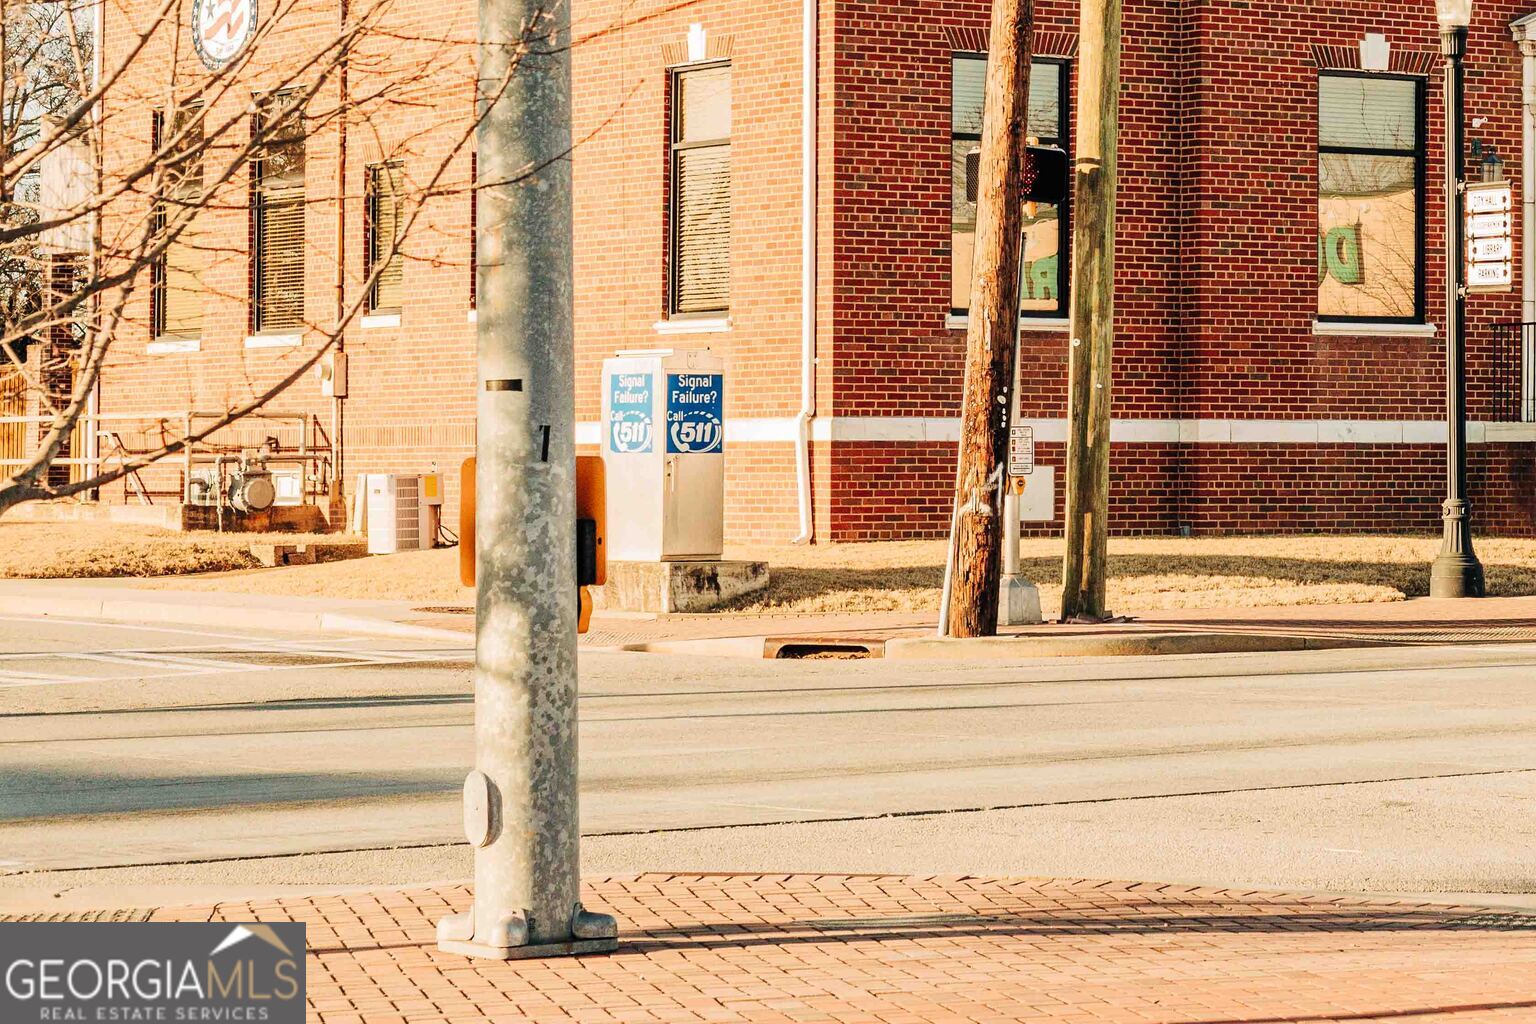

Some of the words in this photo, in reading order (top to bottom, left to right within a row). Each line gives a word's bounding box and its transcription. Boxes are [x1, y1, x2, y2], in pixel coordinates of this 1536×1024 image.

[618, 374, 646, 391] Signal
[678, 374, 713, 391] Signal
[614, 390, 649, 404] Failure?
[671, 390, 718, 404] Failure?
[611, 410, 624, 422] Call
[667, 410, 684, 422] Call
[620, 421, 646, 443] 511
[679, 421, 713, 443] 511
